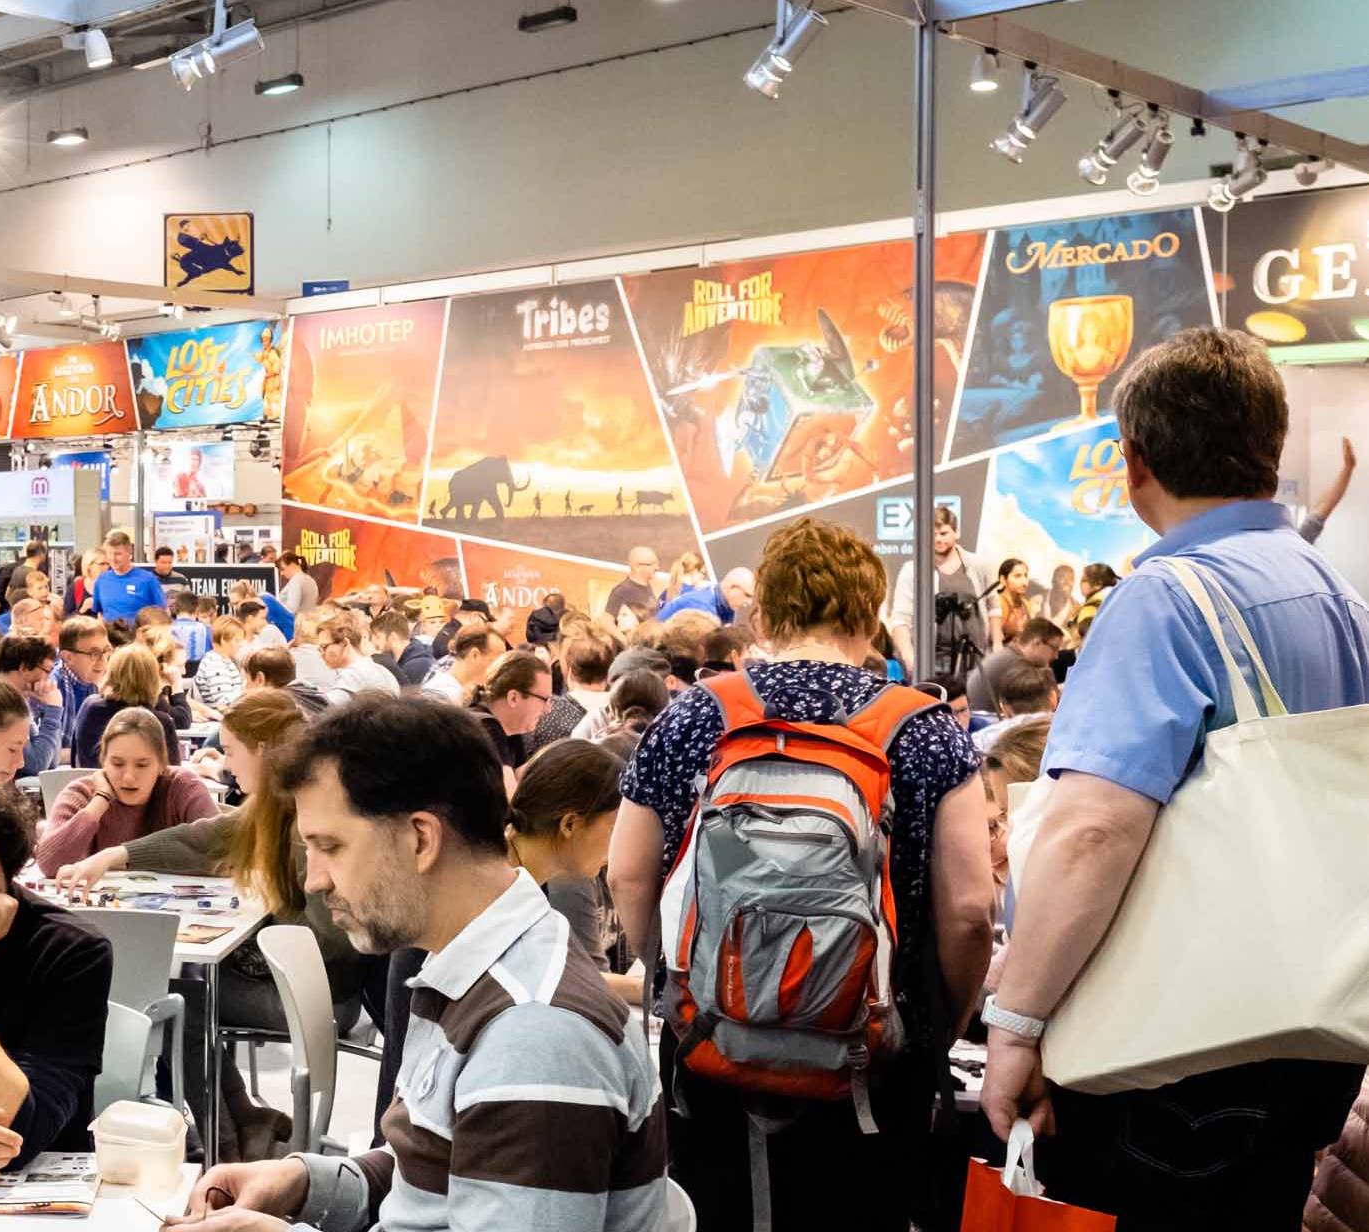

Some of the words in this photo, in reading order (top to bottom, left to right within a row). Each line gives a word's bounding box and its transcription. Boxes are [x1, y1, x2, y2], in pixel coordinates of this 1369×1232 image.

[1006, 231, 1180, 275] MERCADO
[1252, 243, 1369, 305] GE
[694, 279, 735, 305] ROLL
[738, 271, 773, 300] FOR
[319, 319, 415, 351] IMHOTEP
[516, 296, 610, 339] Tribes
[683, 292, 785, 337] ADVENTURE
[166, 337, 229, 381] LOST
[29, 383, 125, 427] ANDOR
[167, 367, 252, 414] CITIES
[1069, 438, 1128, 481] LO
[301, 528, 327, 548] ROLL
[329, 528, 351, 548] FOR
[191, 578, 219, 597] TEAM.
